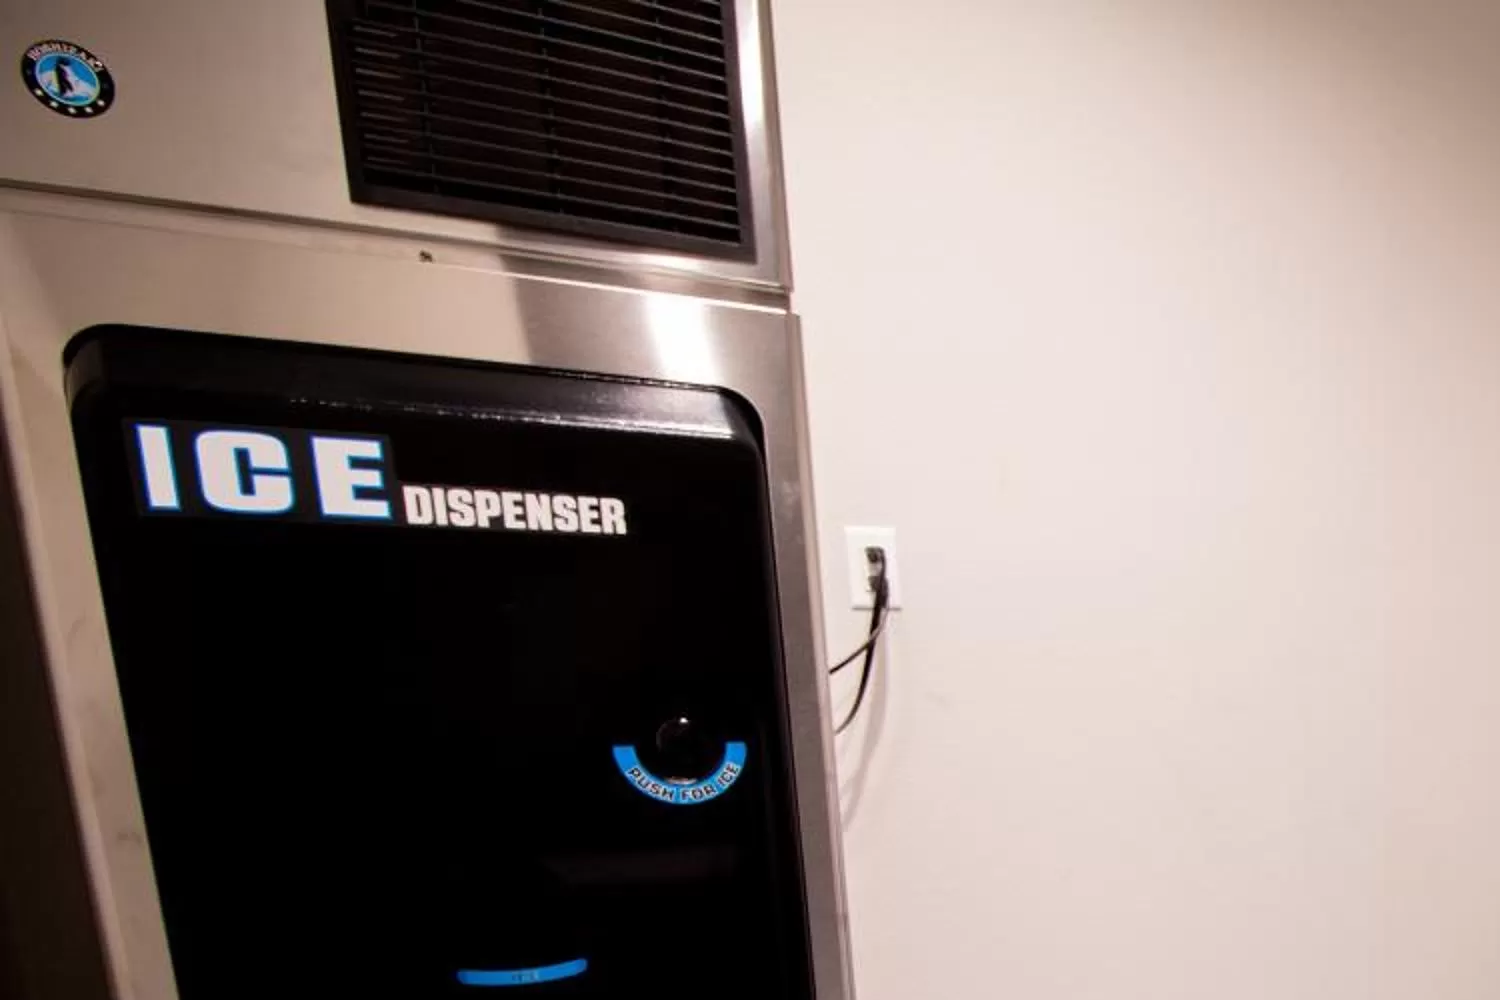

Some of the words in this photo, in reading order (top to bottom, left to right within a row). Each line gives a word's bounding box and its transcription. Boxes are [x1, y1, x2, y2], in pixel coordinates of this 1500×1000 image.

[135, 423, 392, 519] ICE
[402, 485, 628, 535] DISPENSER
[627, 765, 675, 801] PUSH
[680, 784, 718, 802] FOR
[717, 761, 741, 788] ICE
